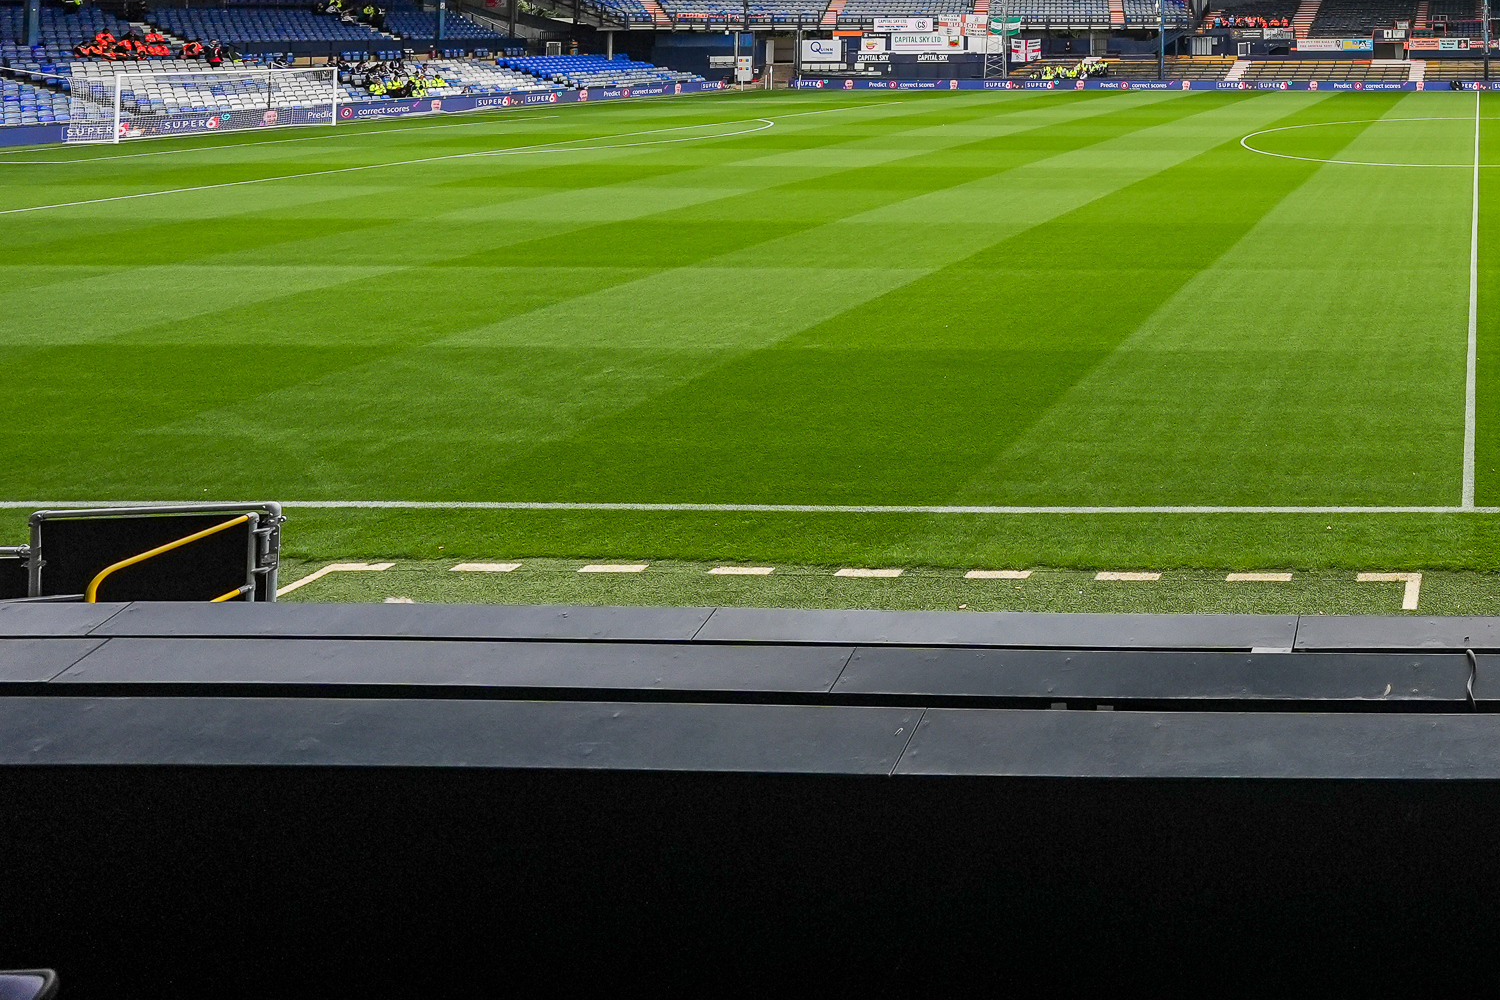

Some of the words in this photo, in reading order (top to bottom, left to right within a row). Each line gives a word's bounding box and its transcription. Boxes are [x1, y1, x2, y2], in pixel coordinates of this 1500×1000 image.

[917, 20, 926, 29] CS
[899, 81, 918, 89] correct
[603, 90, 621, 98] Predict
[632, 88, 648, 96] correct
[357, 106, 387, 115] correct
[387, 104, 410, 113] scores
[164, 115, 219, 130] SUPER6
